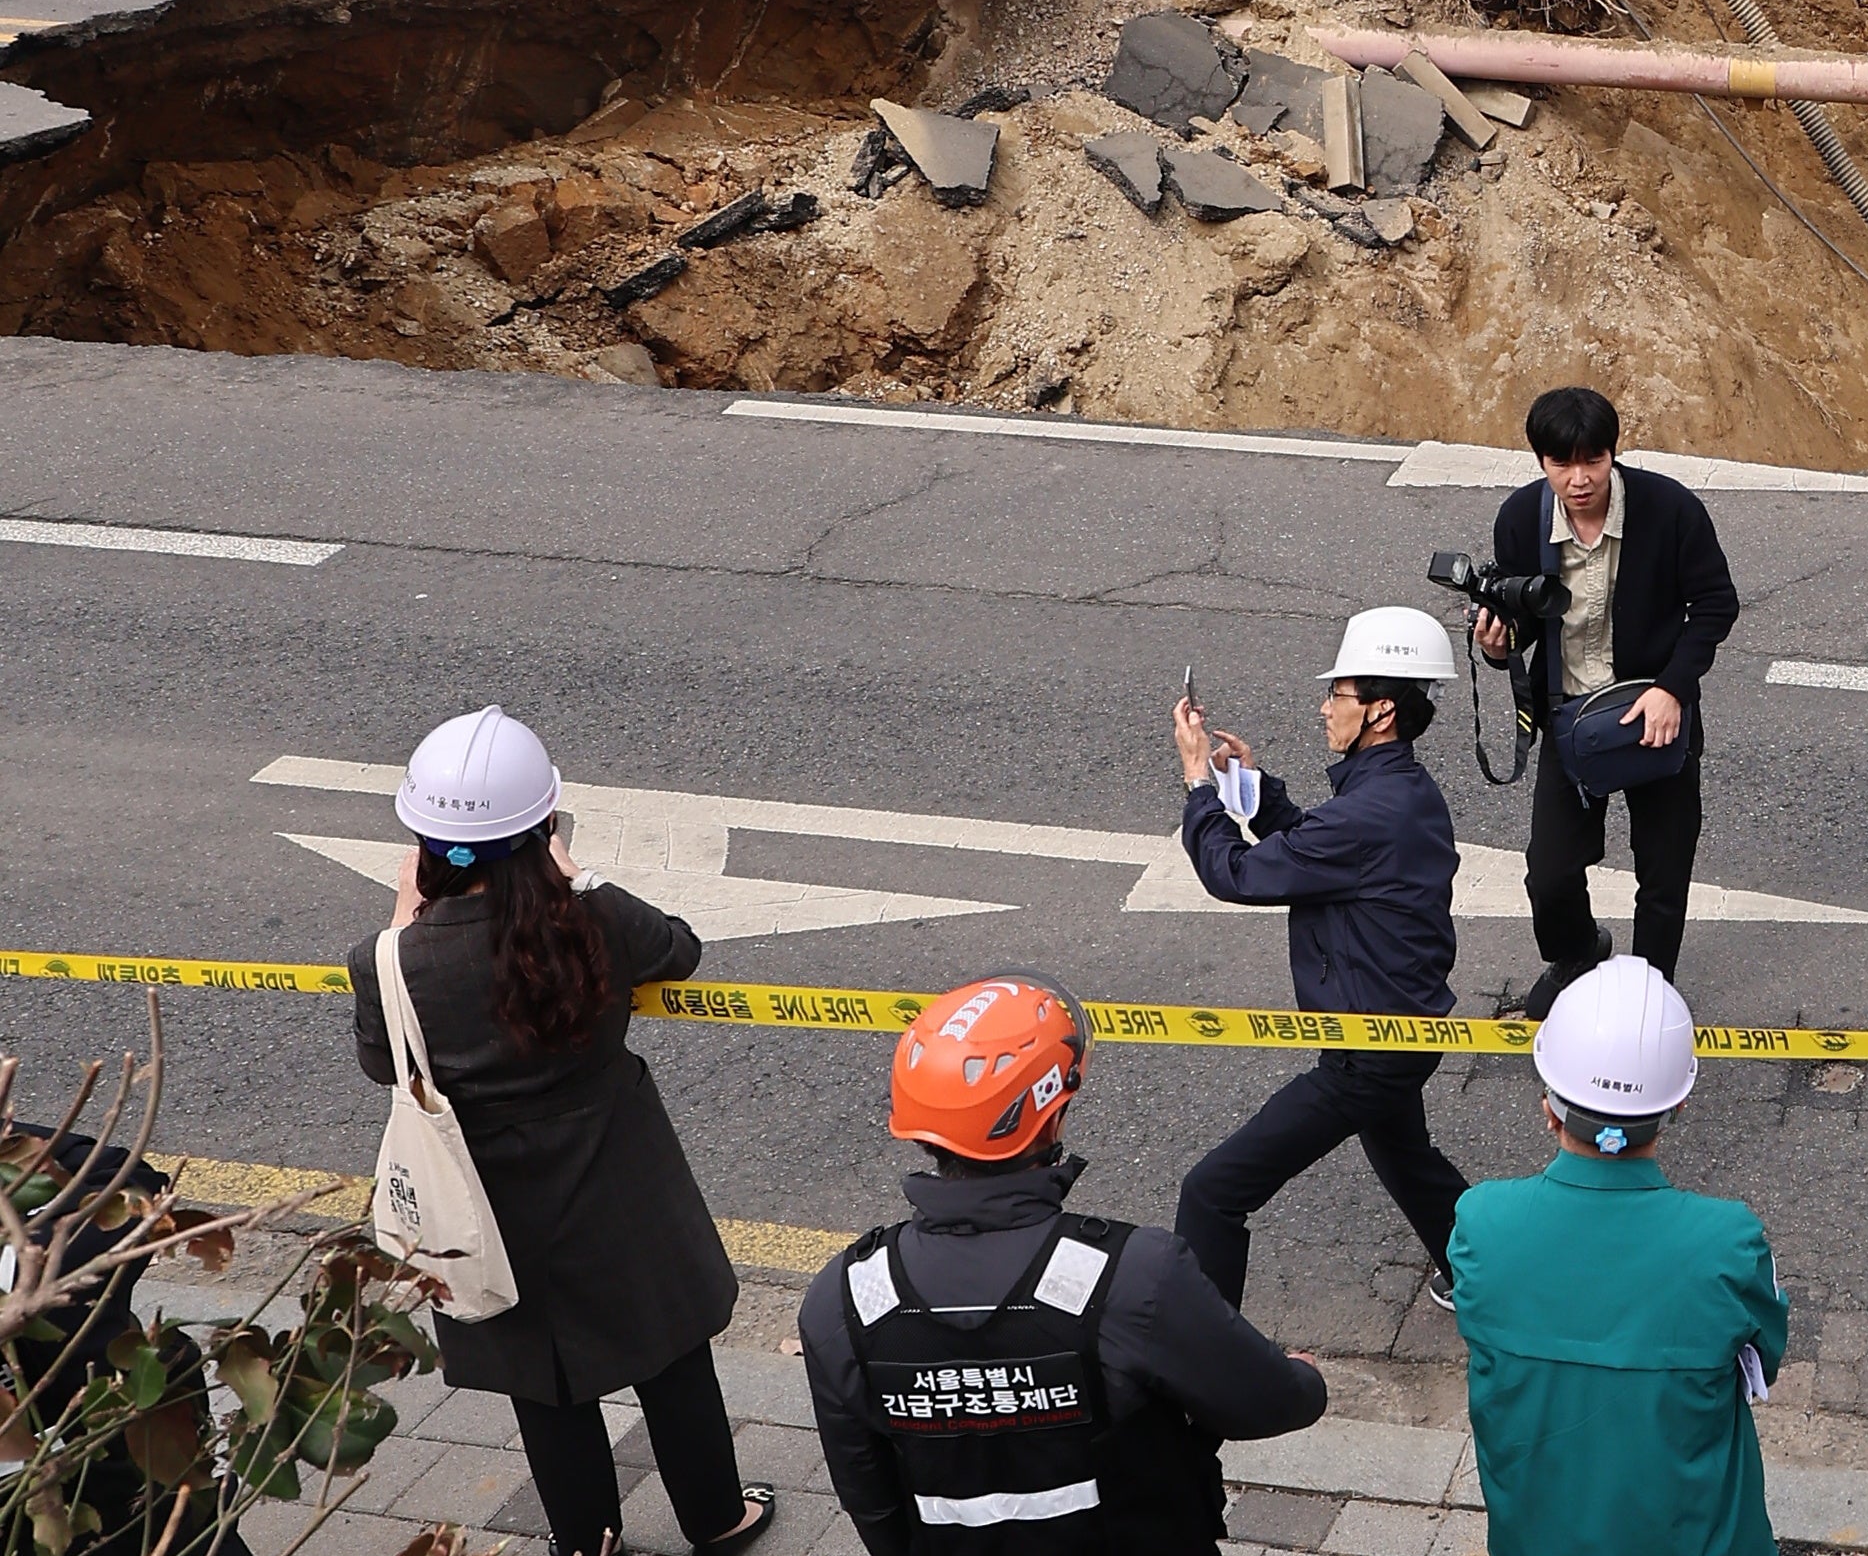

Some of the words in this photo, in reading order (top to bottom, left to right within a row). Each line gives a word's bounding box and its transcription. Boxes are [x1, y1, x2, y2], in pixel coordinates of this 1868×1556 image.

[426, 794, 490, 812] 서울특별시
[1590, 1075, 1644, 1095] 서울특별시
[913, 1365, 1034, 1392] 서울특별시
[881, 1384, 1078, 1419] 긴급구조통제단
